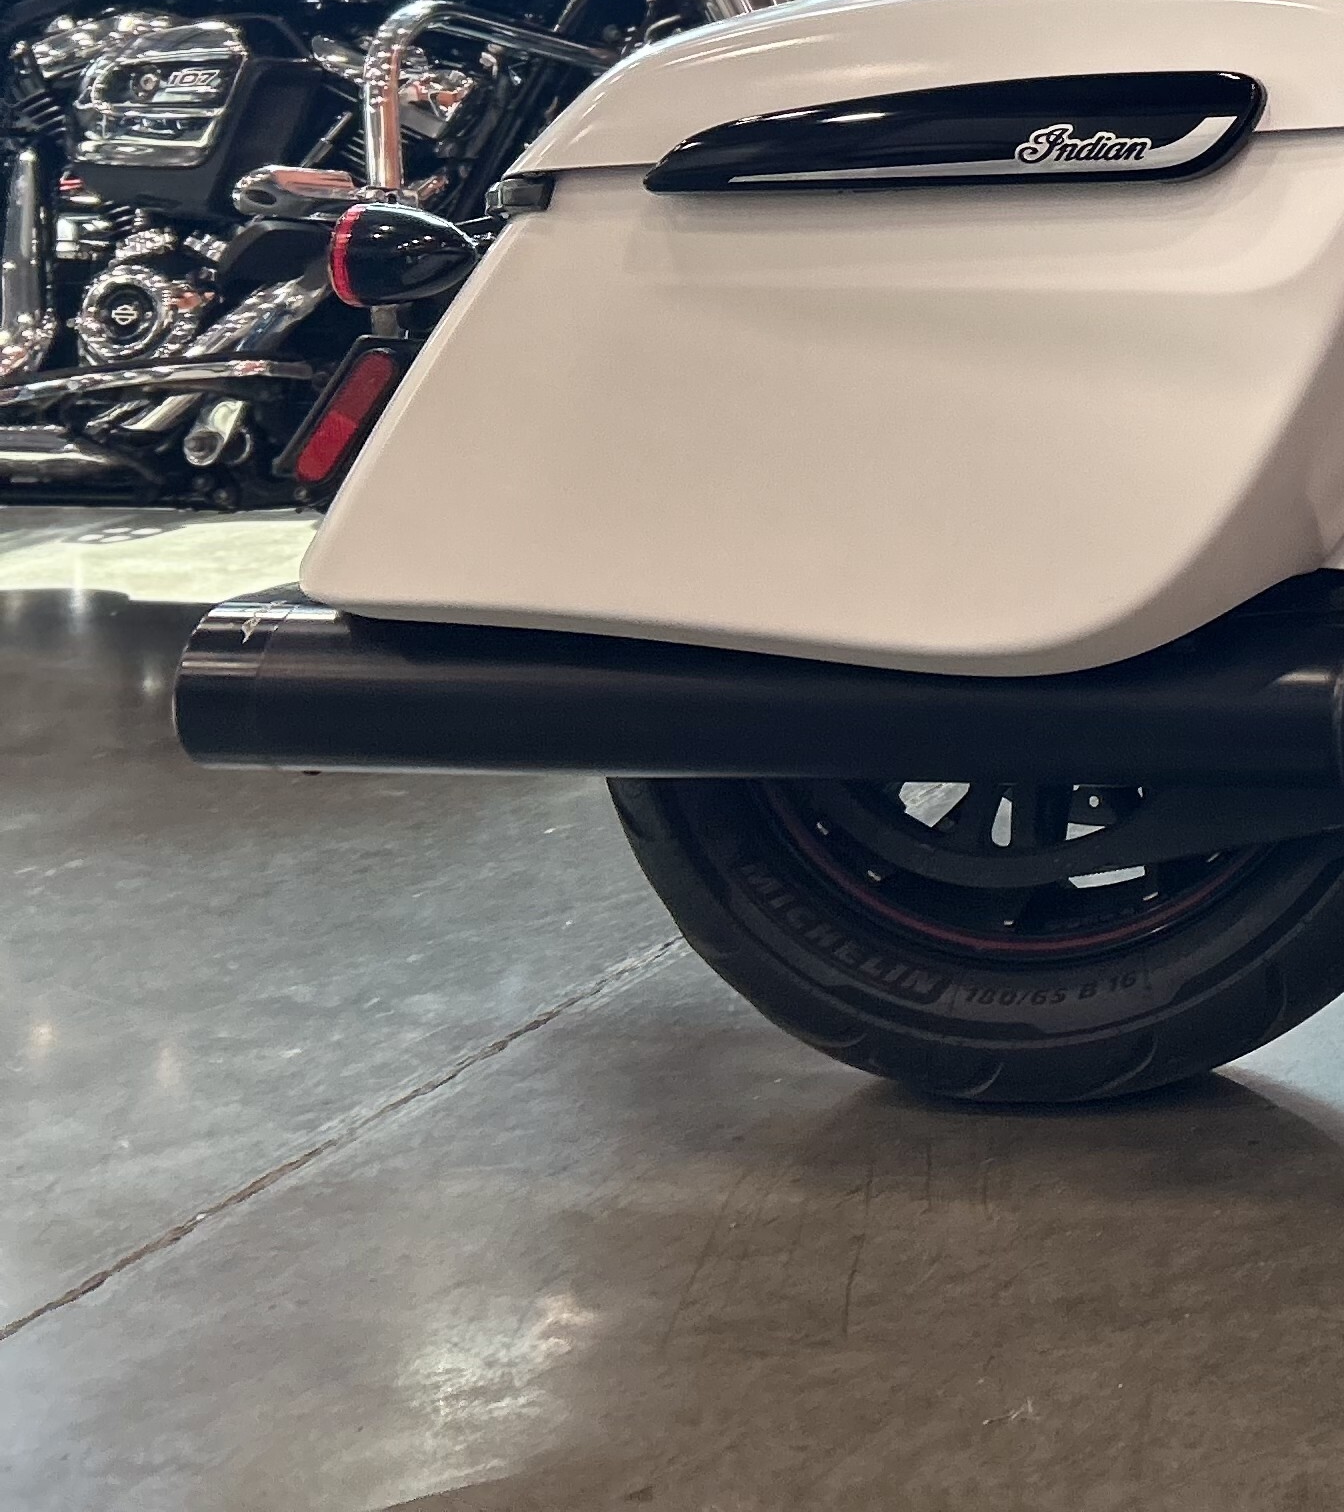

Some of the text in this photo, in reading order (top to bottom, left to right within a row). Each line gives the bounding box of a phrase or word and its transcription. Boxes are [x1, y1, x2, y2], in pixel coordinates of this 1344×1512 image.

[168, 68, 219, 87] 107
[1017, 126, 1150, 164] Indian
[741, 863, 938, 994] MICHELIN
